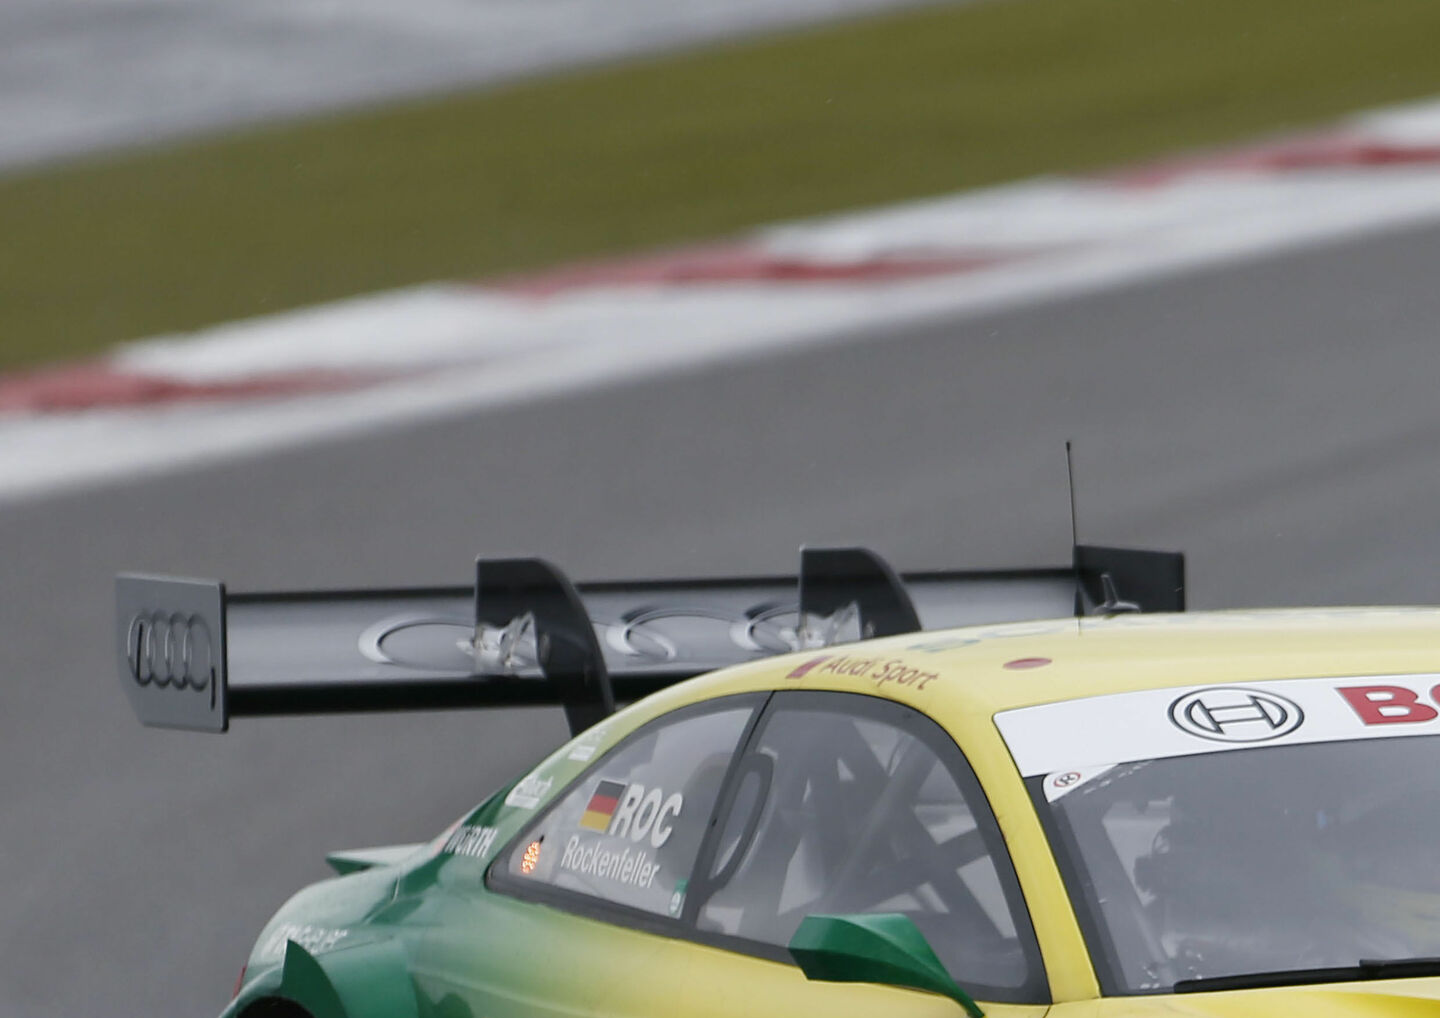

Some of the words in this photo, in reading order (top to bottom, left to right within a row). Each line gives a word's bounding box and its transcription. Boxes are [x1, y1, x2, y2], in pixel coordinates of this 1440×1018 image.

[824, 656, 870, 675] Audi
[873, 659, 938, 690] Sport
[609, 784, 682, 848] ROC
[561, 834, 660, 888] Rockenfeller
